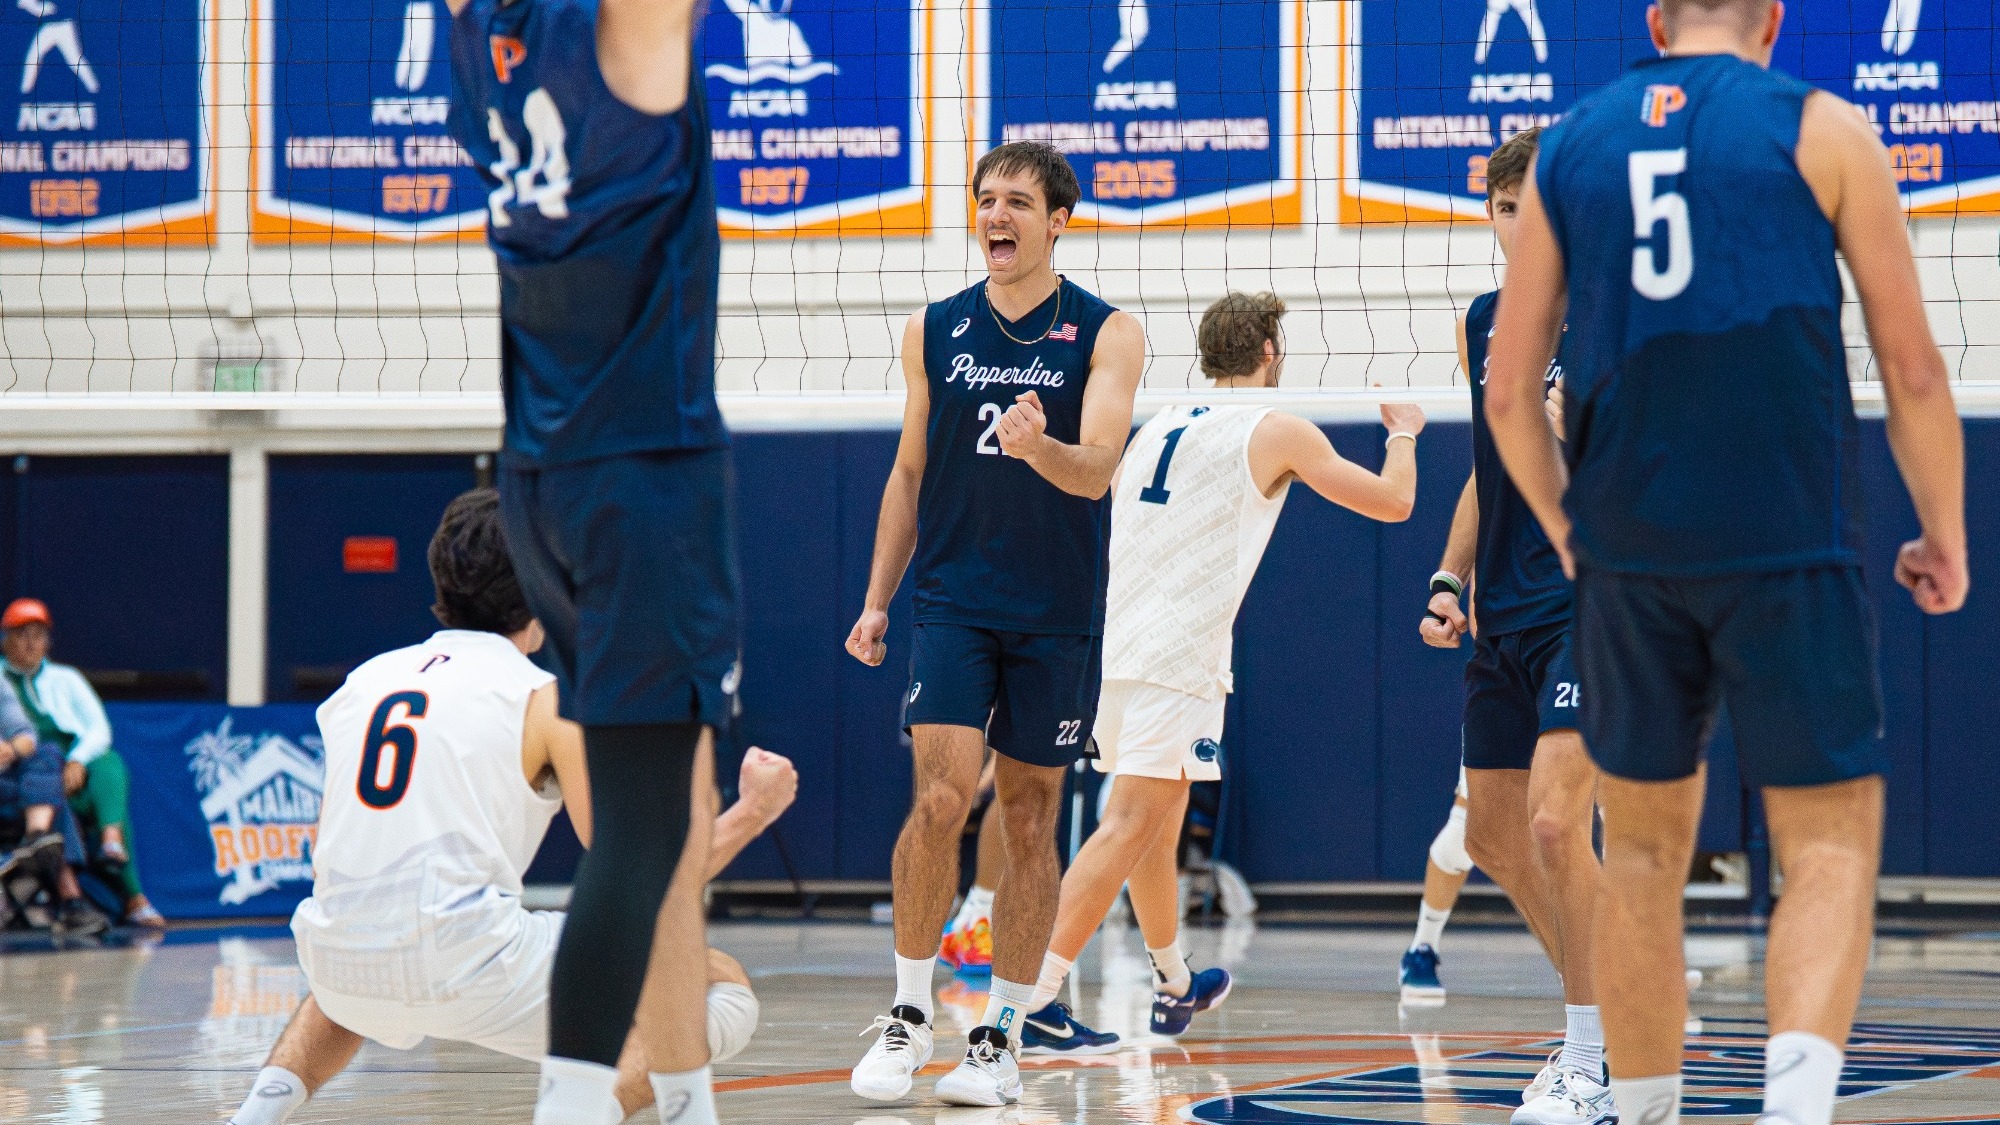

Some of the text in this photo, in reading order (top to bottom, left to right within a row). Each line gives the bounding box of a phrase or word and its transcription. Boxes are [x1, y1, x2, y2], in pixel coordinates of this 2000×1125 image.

[489, 35, 527, 84] P
[1853, 61, 1940, 91] NCAA
[729, 89, 808, 118] NCAA
[1094, 81, 1178, 111] NCAA
[1468, 73, 1554, 103] NCAA
[372, 96, 450, 126] NCAA
[760, 126, 901, 159] CHAMPIONS
[1124, 118, 1270, 152] CHAMPIONS
[1373, 115, 1495, 149] NATIONAL
[52, 139, 191, 172] CHAMPIONS
[285, 136, 400, 169] NATIONAL
[1093, 160, 1175, 199] 2005
[1630, 147, 1694, 301] 5
[945, 353, 1065, 390] Pepperdine
[976, 402, 1010, 456] 2
[1139, 425, 1189, 505] 1
[1055, 719, 1081, 746] 22
[356, 690, 429, 810] 6
